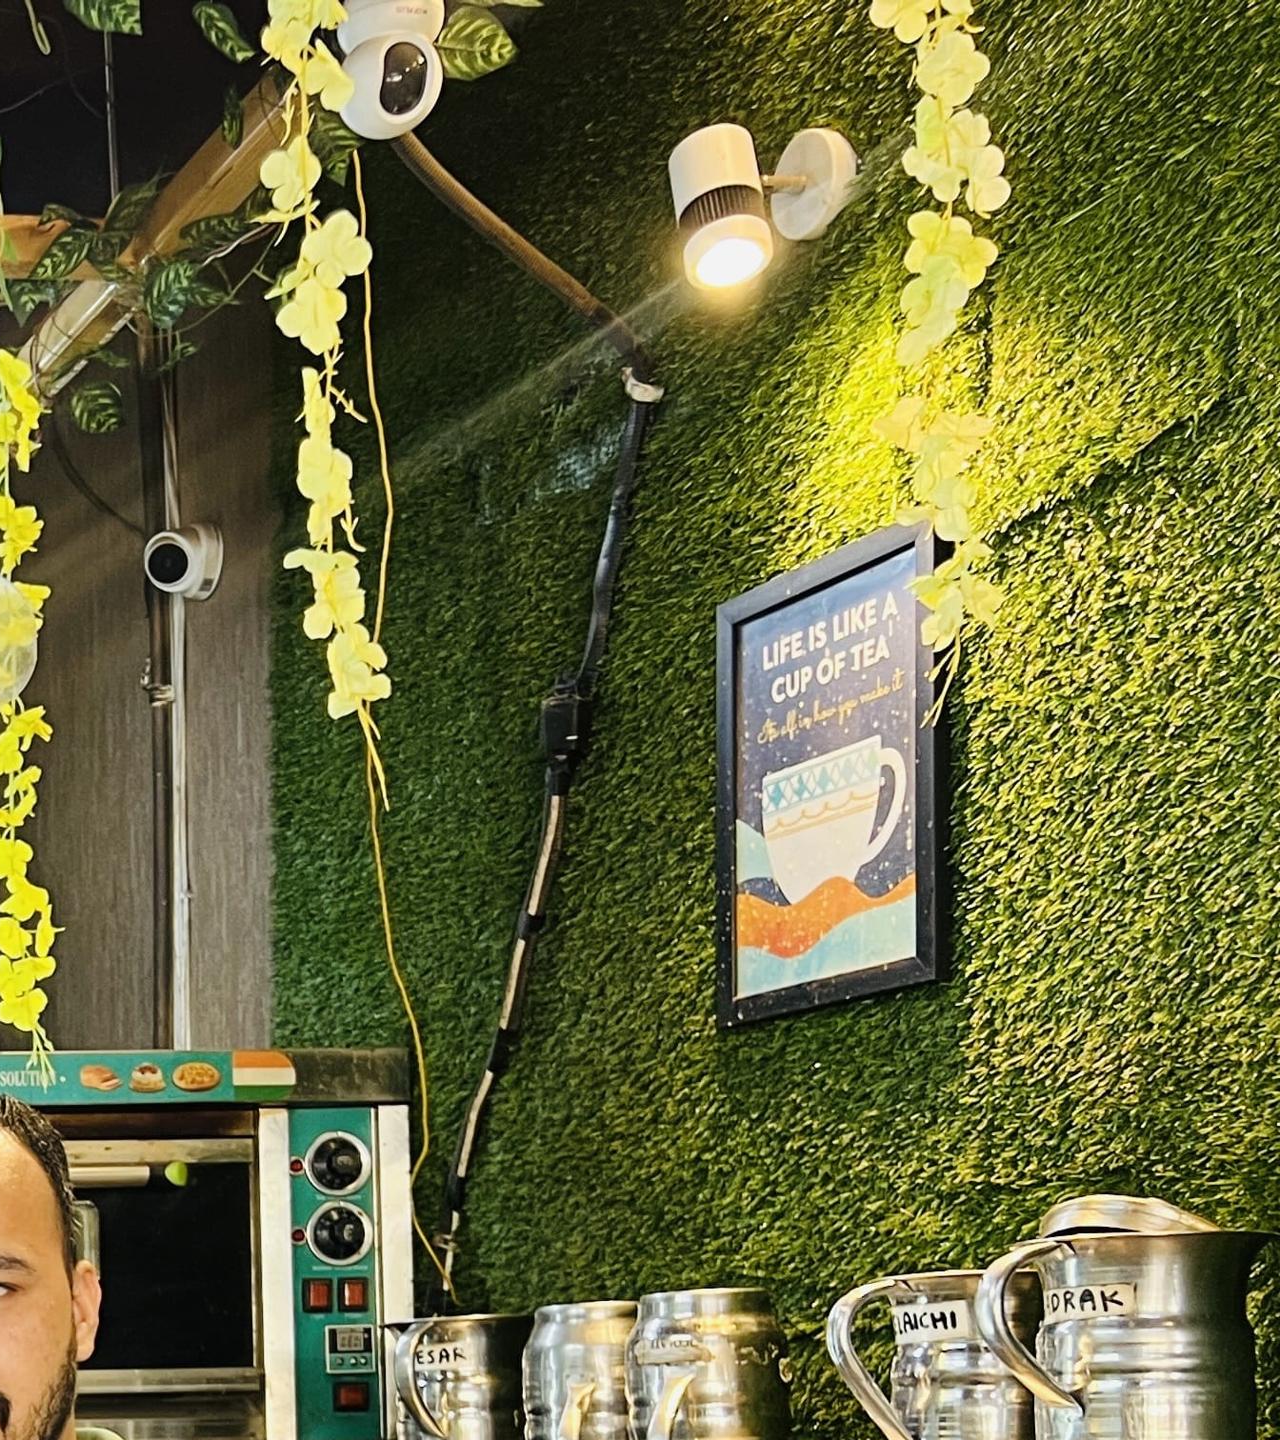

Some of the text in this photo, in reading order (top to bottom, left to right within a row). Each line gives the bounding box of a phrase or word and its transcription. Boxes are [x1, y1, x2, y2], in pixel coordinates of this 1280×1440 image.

[762, 591, 899, 672] LIFE IS LIKE A
[771, 634, 890, 704] CUP OF TEA
[0, 1070, 57, 1087] SOLUTI
[895, 1310, 957, 1335] LAICHI
[415, 1347, 467, 1365] ESAR
